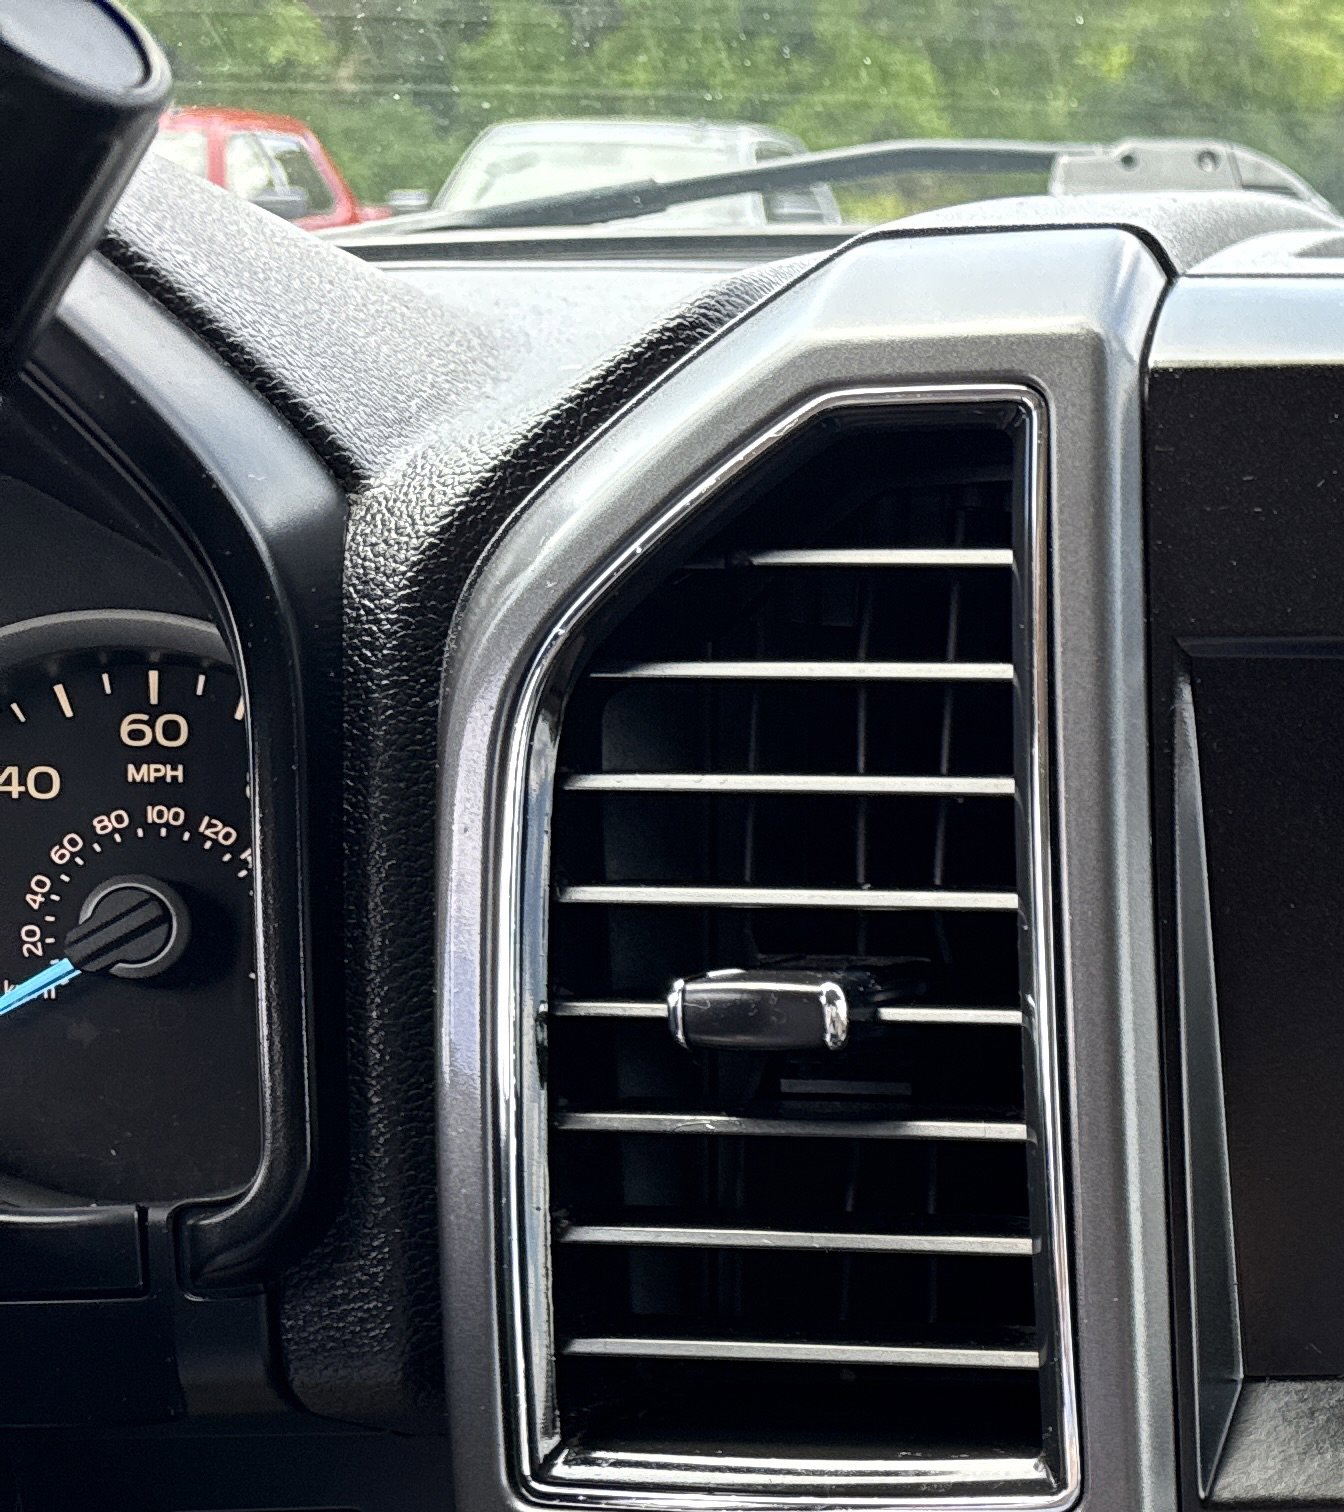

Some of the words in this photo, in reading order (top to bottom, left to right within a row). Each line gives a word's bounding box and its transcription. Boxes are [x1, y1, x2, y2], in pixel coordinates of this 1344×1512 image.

[120, 714, 188, 747] 60
[0, 766, 61, 799] 40
[128, 764, 183, 783] MPH
[93, 809, 129, 836] 80
[146, 806, 185, 826] 100
[199, 815, 237, 846] 120
[51, 833, 84, 865] 60
[26, 875, 51, 909] 40
[21, 924, 43, 957] 20
